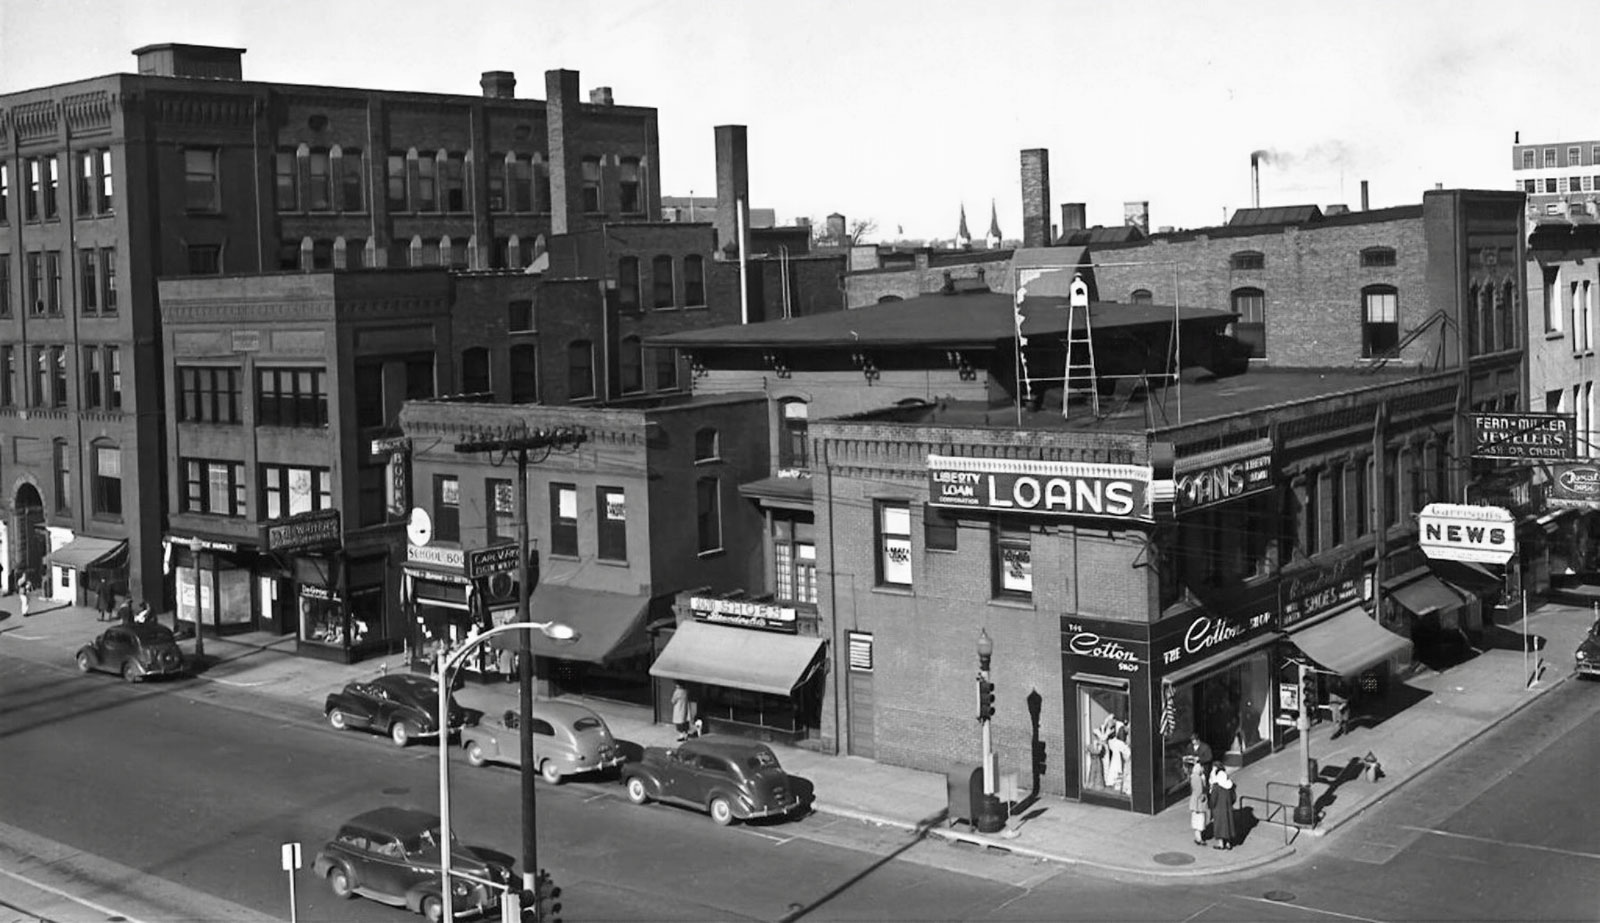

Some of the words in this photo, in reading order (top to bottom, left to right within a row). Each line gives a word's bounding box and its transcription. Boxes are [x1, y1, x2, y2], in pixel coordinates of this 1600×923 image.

[1477, 432, 1563, 445] JEWELERS
[1509, 446, 1525, 455] OR
[1529, 446, 1566, 458] CREDIT
[394, 452, 404, 516] BOOKS
[933, 472, 980, 485] LIBERTY
[1178, 463, 1244, 507] OANS
[942, 484, 974, 496] LOAN
[988, 474, 1134, 516] LOANS
[1426, 523, 1506, 545] NEWS
[408, 548, 442, 562] SCHOOL
[1069, 632, 1139, 661] Cotton
[1163, 646, 1181, 664] THE
[1184, 616, 1246, 653] Cotton
[1118, 662, 1139, 672] SHOP
